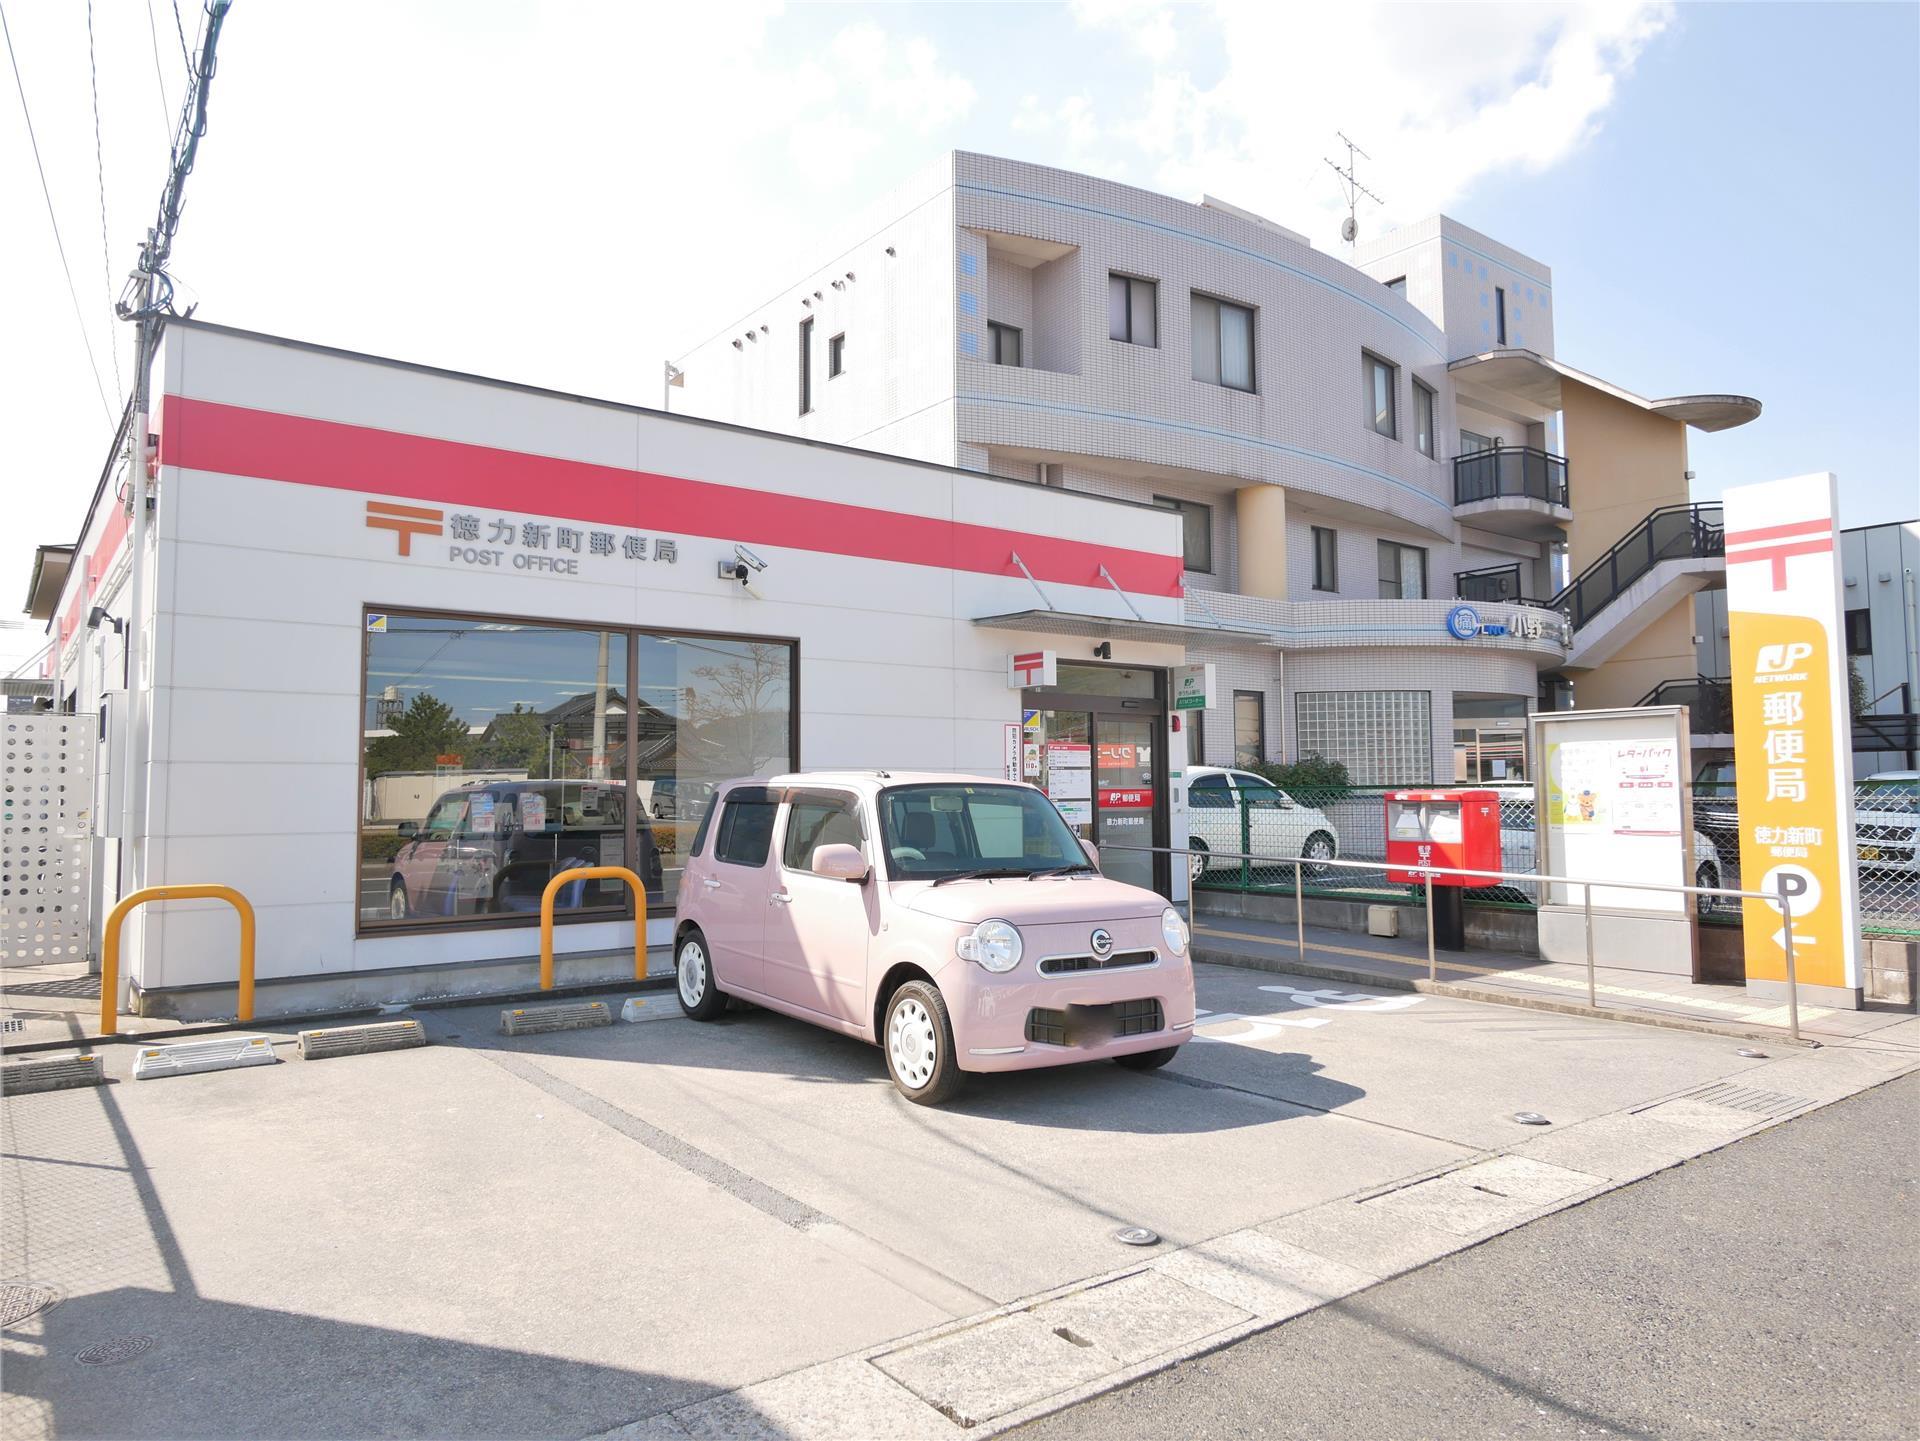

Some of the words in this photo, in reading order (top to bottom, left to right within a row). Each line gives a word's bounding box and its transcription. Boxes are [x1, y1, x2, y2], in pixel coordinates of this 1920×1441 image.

[450, 513, 679, 564] 徳力新町郵便局
[450, 546, 504, 567] POST
[513, 553, 579, 575] OFFICE
[1756, 642, 1812, 673] JP
[1753, 672, 1808, 684] NETWORK
[1762, 691, 1807, 803] 郵便局
[1755, 826, 1823, 847] 徳力新町
[1777, 872, 1807, 909] P
